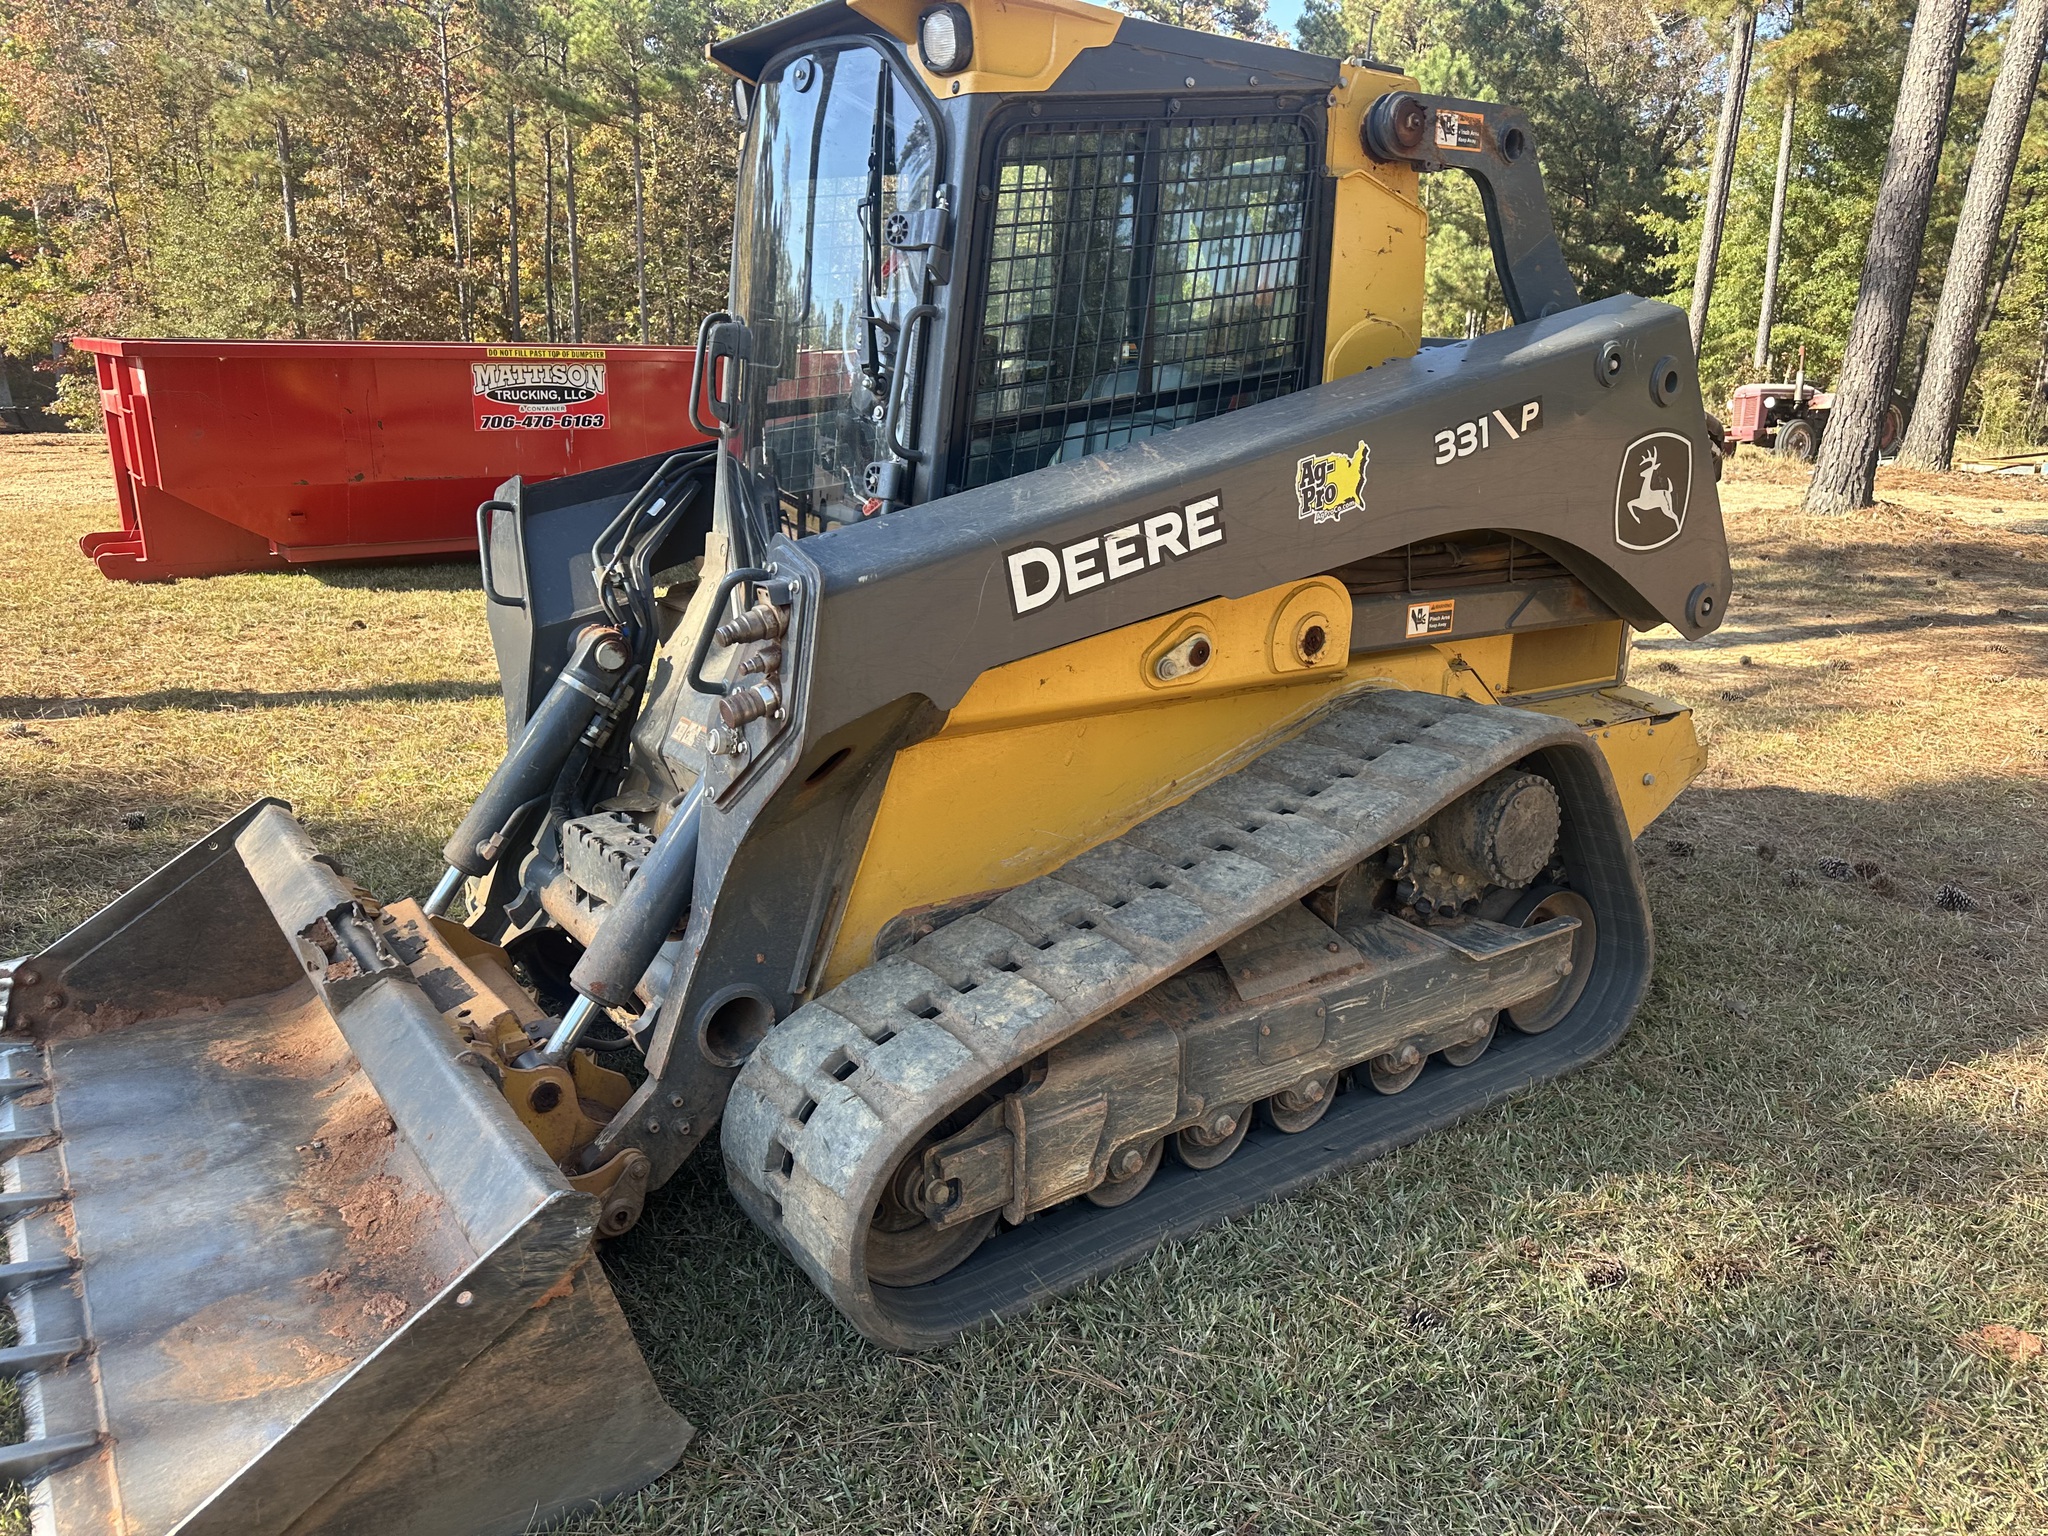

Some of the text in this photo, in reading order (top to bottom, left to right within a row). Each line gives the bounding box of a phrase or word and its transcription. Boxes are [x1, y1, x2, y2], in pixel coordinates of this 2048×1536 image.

[500, 349, 513, 357] NOT
[547, 350, 560, 358] TOP
[571, 351, 605, 359] DUMPSTER
[473, 364, 605, 394] MATTISON
[495, 390, 587, 401] TRUCKING, LLC
[481, 414, 605, 429] 706-476-6163
[1300, 460, 1334, 488] Ag-
[1301, 484, 1337, 514] Pro
[1007, 495, 1223, 614] DEERE
